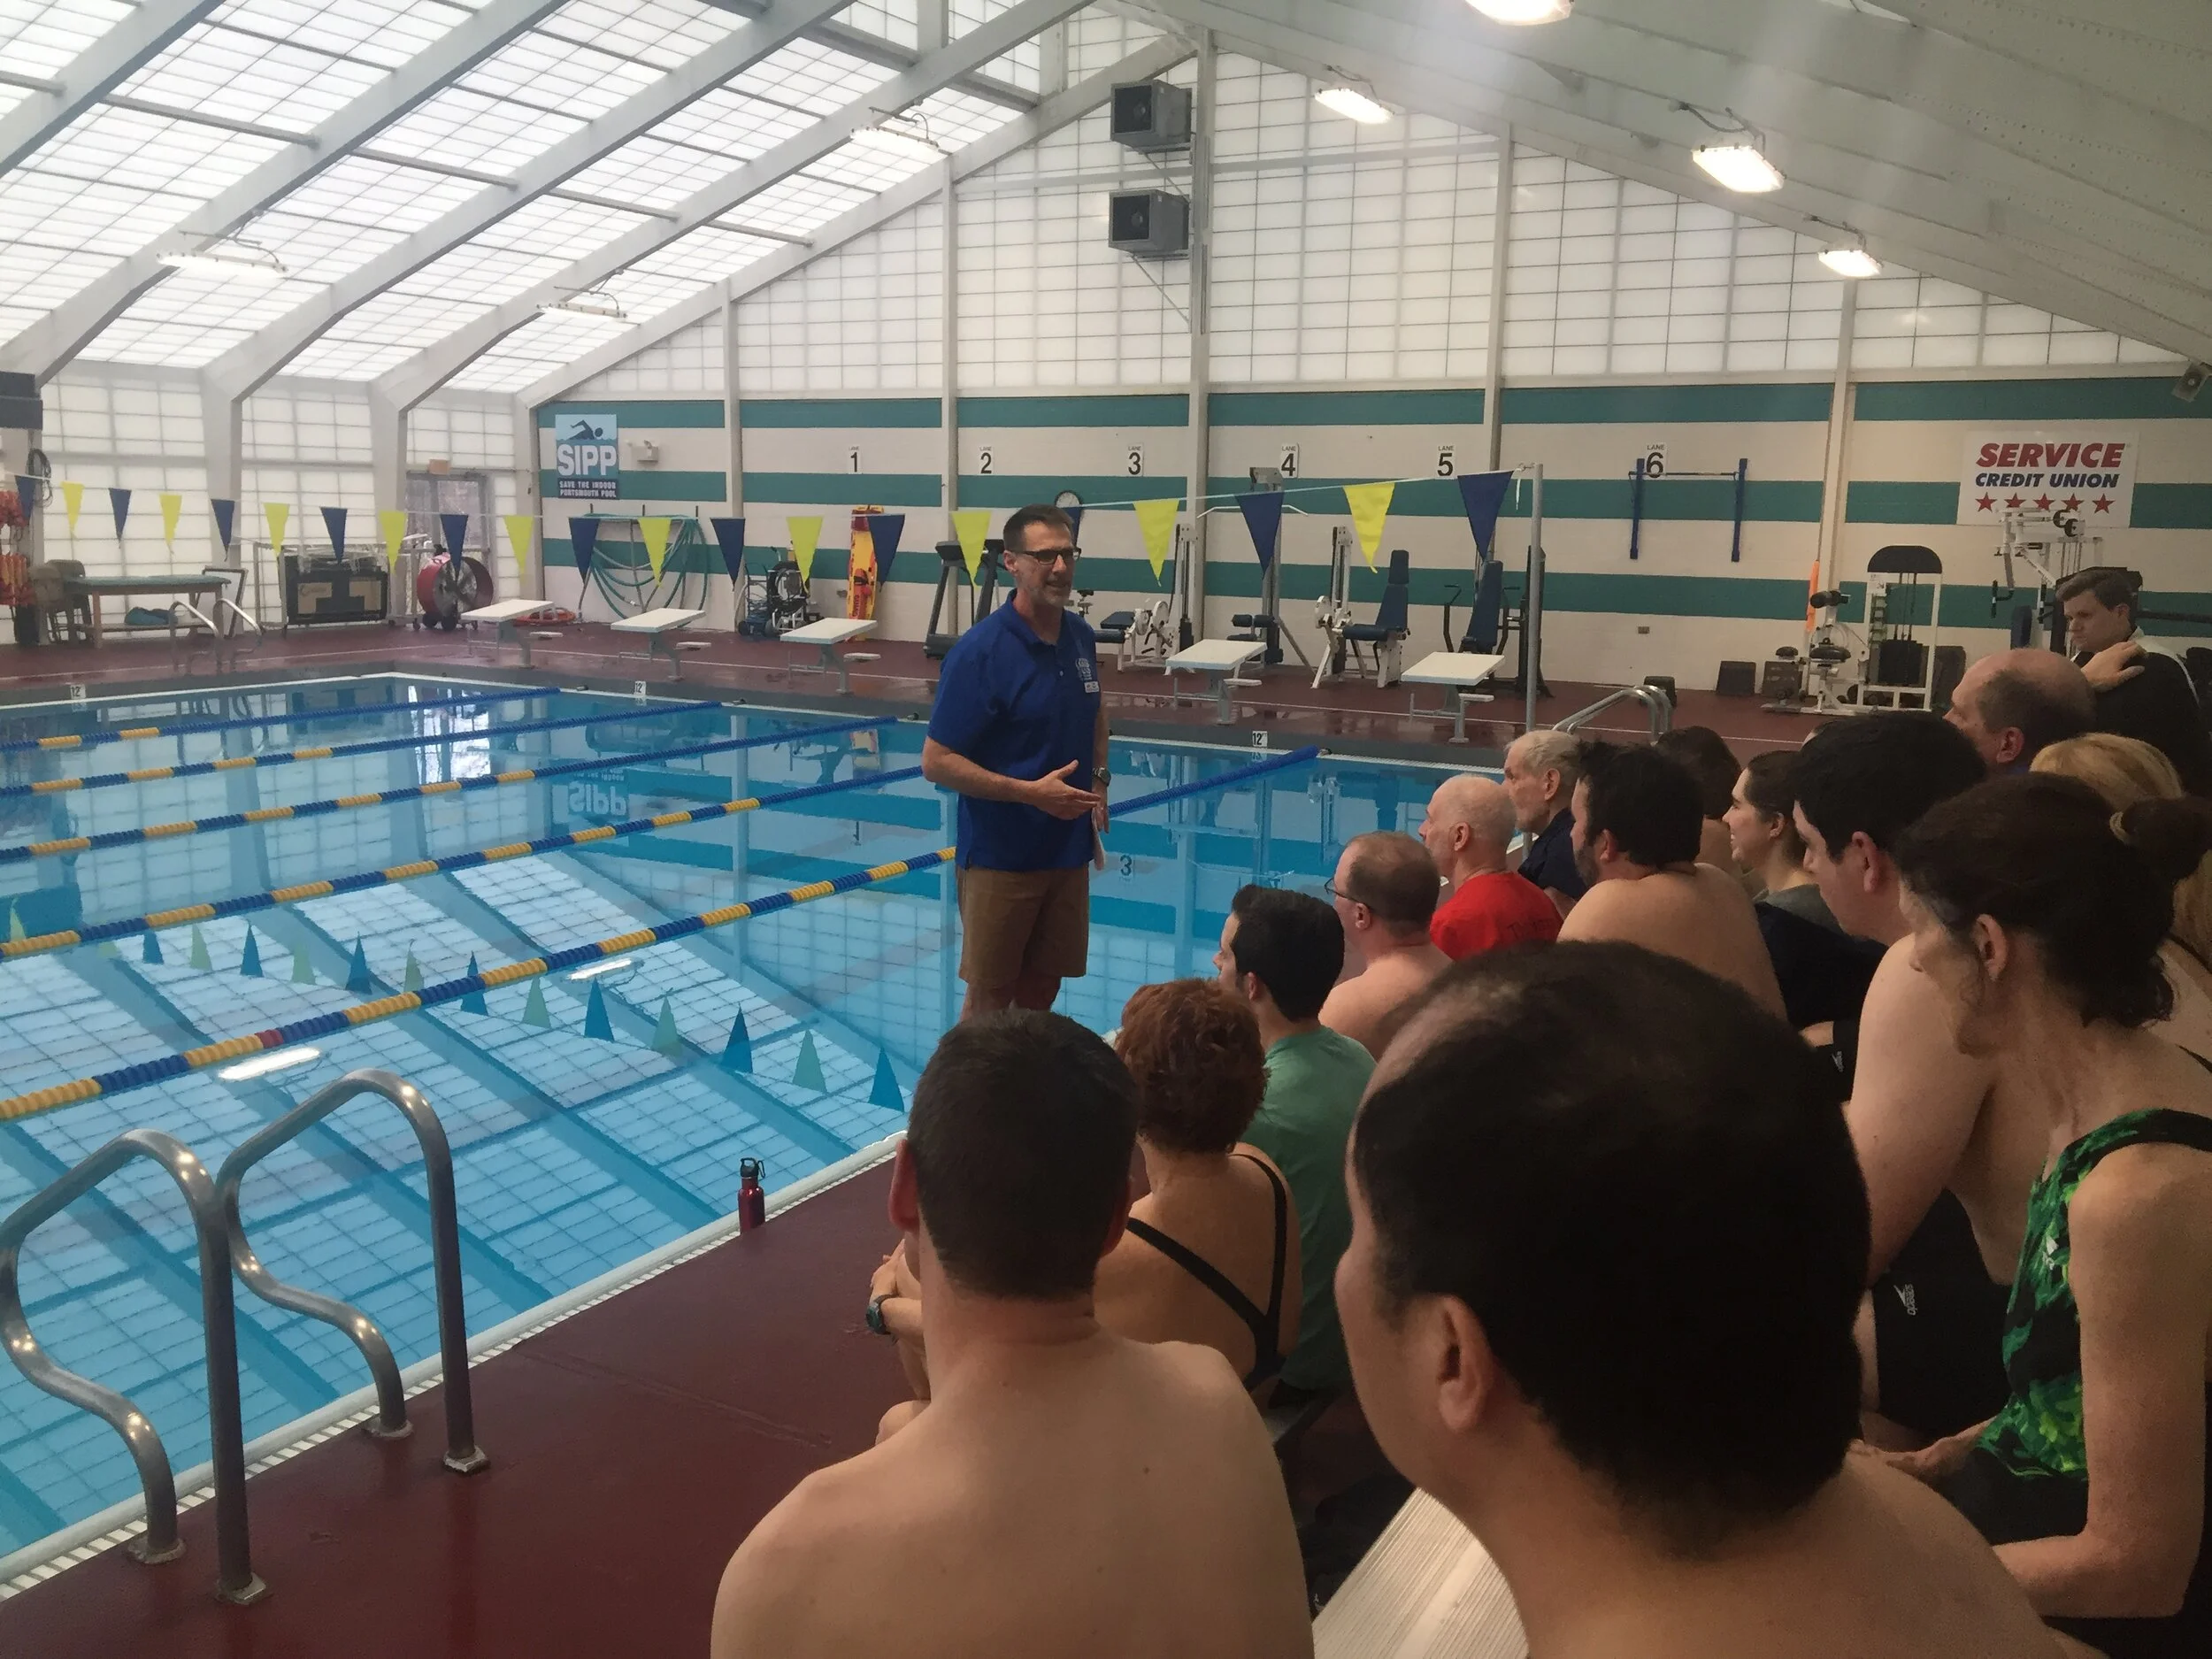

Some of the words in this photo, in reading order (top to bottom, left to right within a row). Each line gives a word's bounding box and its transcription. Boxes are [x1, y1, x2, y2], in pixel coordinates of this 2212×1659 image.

[557, 444, 617, 476] SIPP
[850, 451, 857, 472] 1
[980, 452, 992, 474] 2
[1128, 452, 1141, 475] 3
[1281, 453, 1296, 477] 4
[1437, 452, 1454, 477] 5
[1646, 452, 1663, 479] 6
[1976, 442, 2125, 468] SERVICE
[1976, 472, 2045, 488] CREDIT
[2049, 472, 2120, 488] UNION
